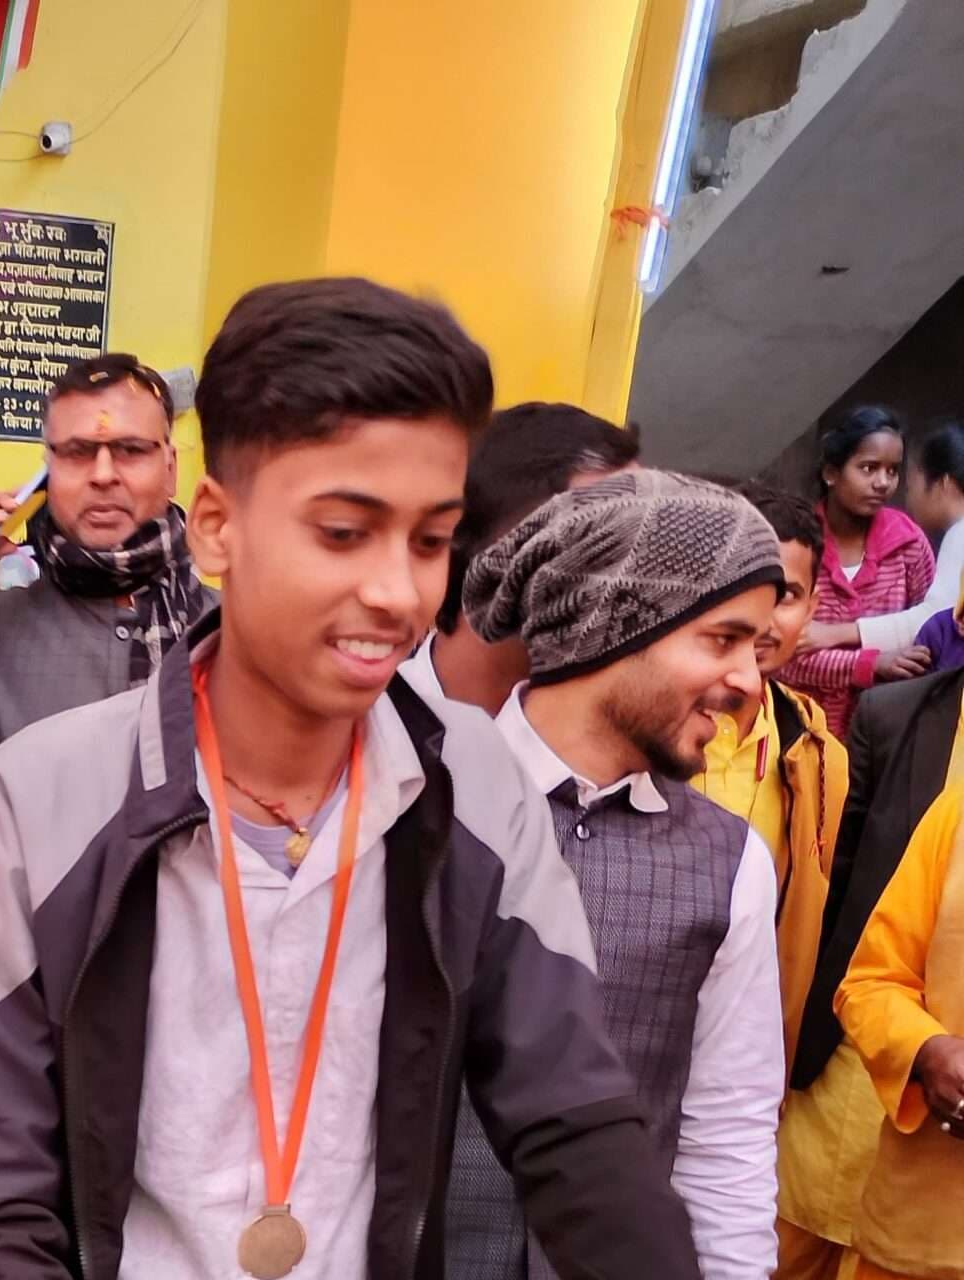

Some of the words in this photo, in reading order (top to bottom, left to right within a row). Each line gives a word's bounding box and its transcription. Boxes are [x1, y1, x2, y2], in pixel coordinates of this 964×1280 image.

[64, 247, 106, 266] भगवती
[77, 268, 105, 285] भवन
[0, 278, 15, 296] एवं
[2, 414, 32, 432] किया
